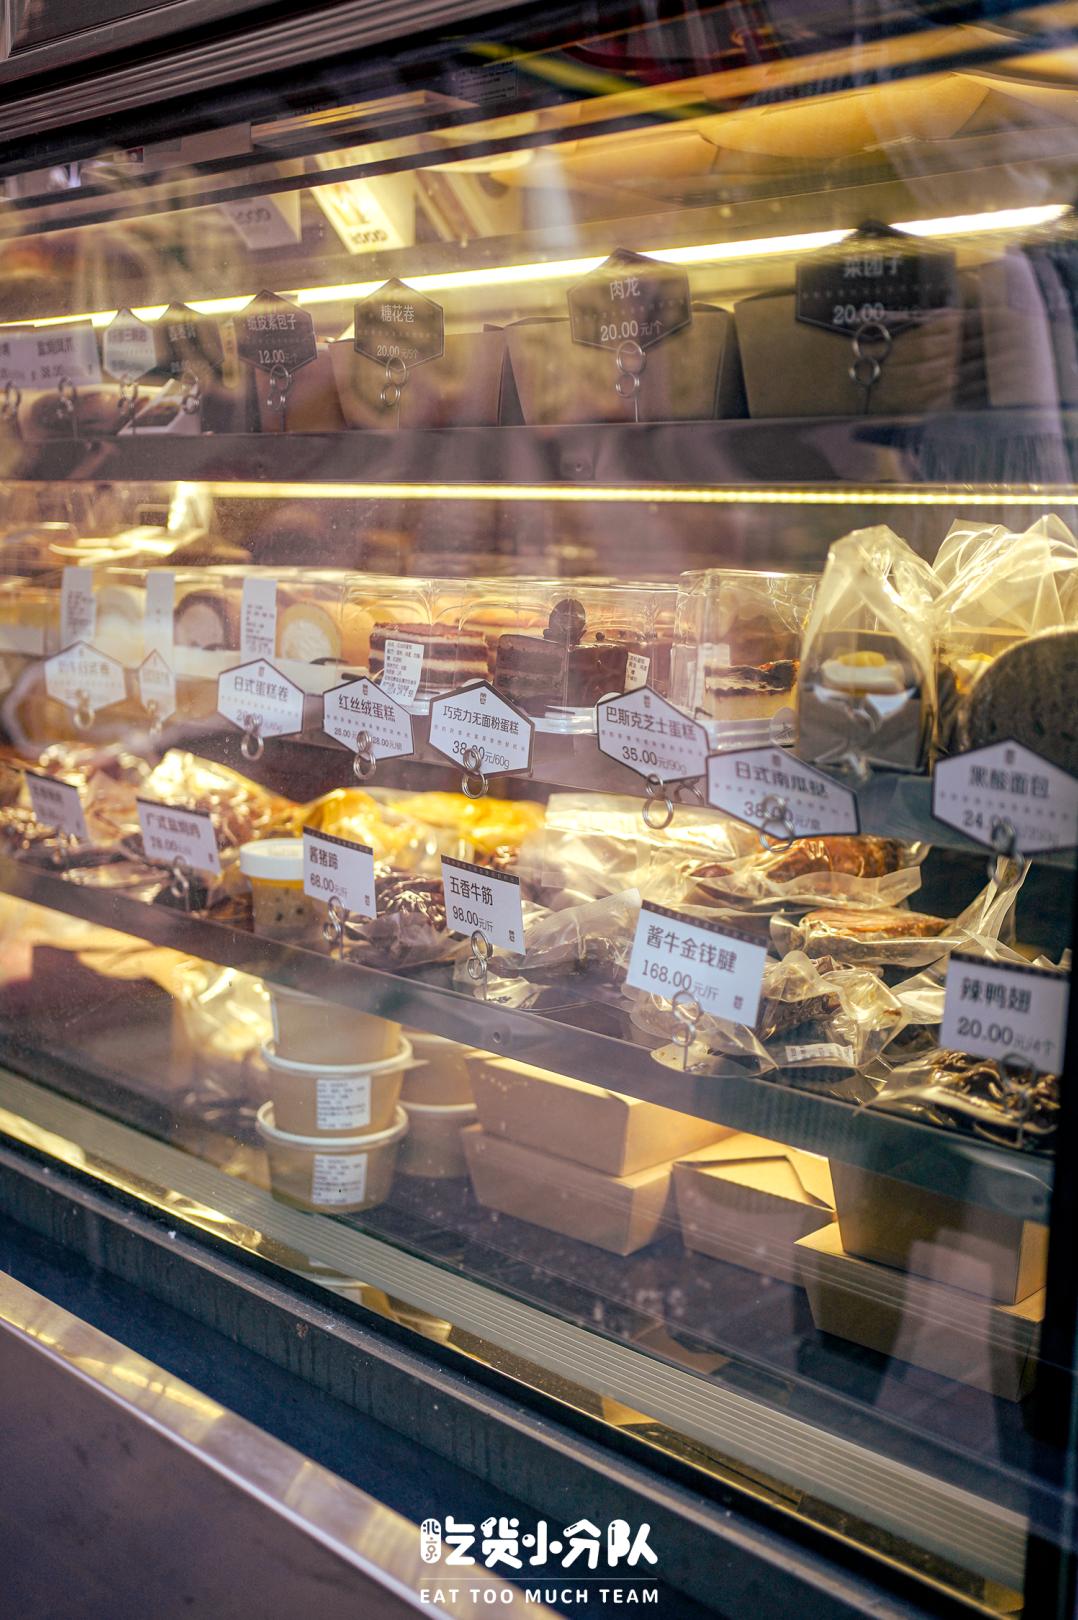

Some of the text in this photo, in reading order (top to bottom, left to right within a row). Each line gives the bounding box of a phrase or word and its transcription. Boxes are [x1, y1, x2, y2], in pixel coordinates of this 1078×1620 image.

[610, 277, 641, 300] 肉龙
[234, 675, 289, 702] 日式蛋糕卷
[338, 693, 396, 722] 红丝绒蛋糕
[443, 705, 519, 735] 巧克力无面粉蛋糕
[606, 705, 697, 741] 巴斯克芝士蛋糕
[449, 876, 493, 906] 五香牛筋
[453, 905, 494, 932] 98.00元/斤
[646, 924, 738, 974] 酱牛金钱腱
[642, 959, 719, 1001] 168.00元/斤
[961, 976, 1033, 1014] 辣鸭翅
